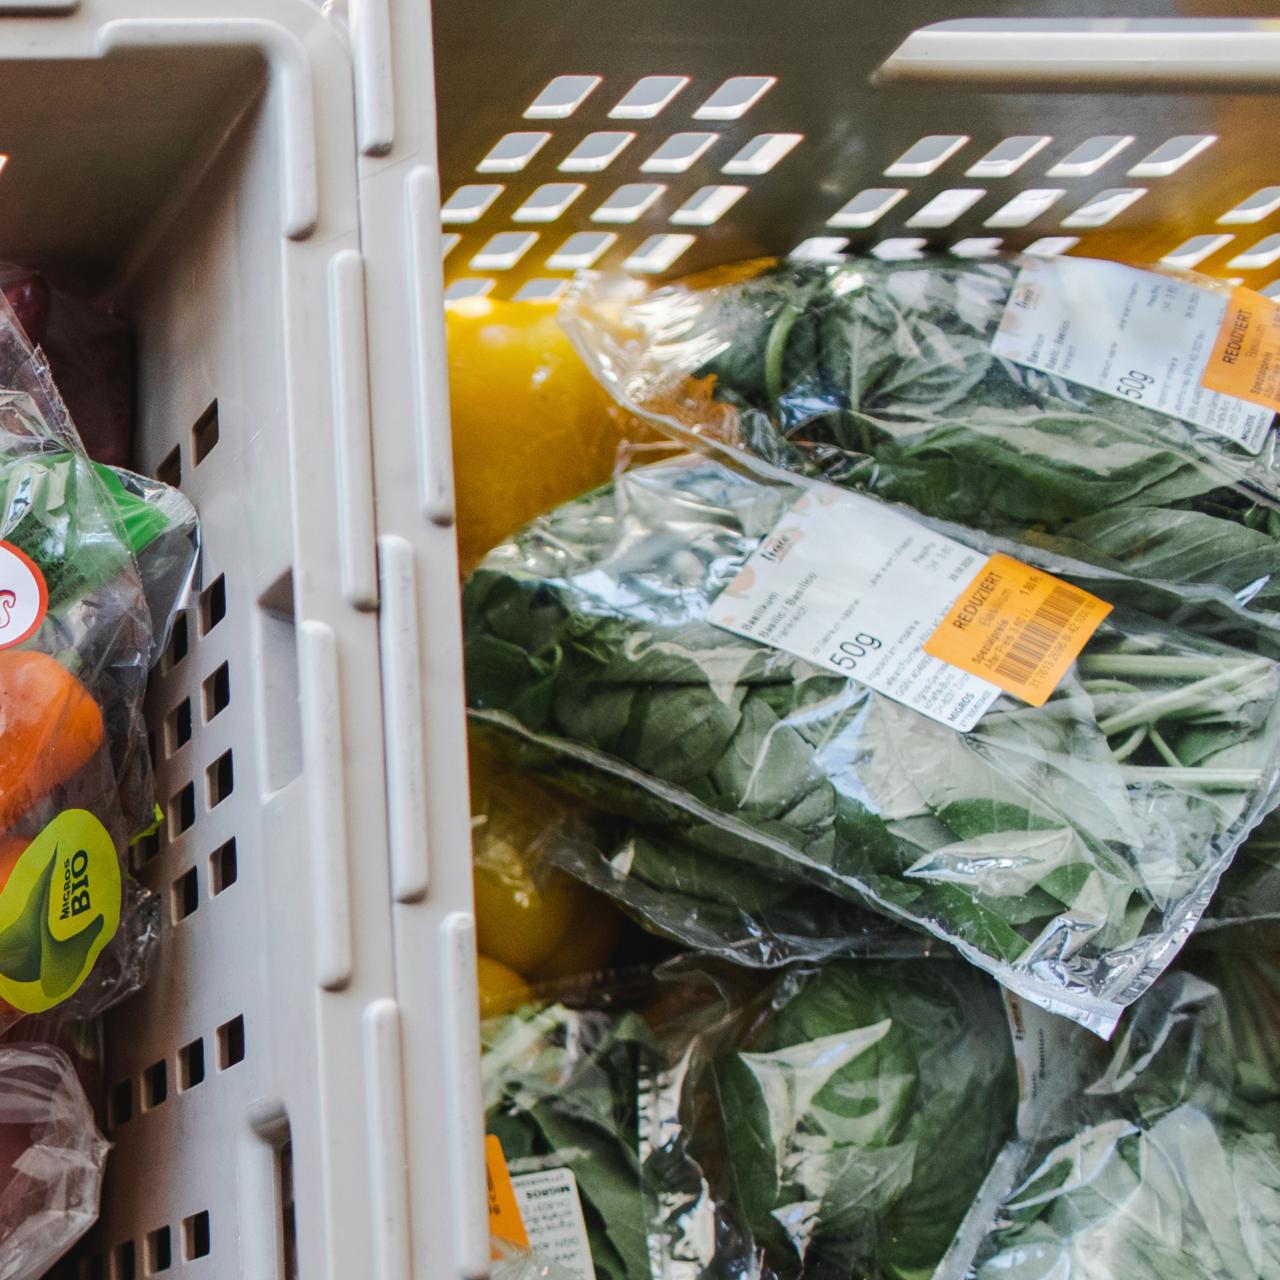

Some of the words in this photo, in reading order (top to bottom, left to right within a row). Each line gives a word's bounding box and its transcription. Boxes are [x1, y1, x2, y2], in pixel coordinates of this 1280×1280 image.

[1221, 308, 1252, 365] REDUZIERT
[1114, 365, 1155, 403] 50g
[951, 570, 1002, 631] REDUZIERT
[829, 622, 884, 679] 50g
[971, 617, 1009, 664] Spezialpreis
[948, 691, 975, 723] MIGROS
[59, 858, 69, 919] MIGROS
[71, 850, 90, 915] BIO
